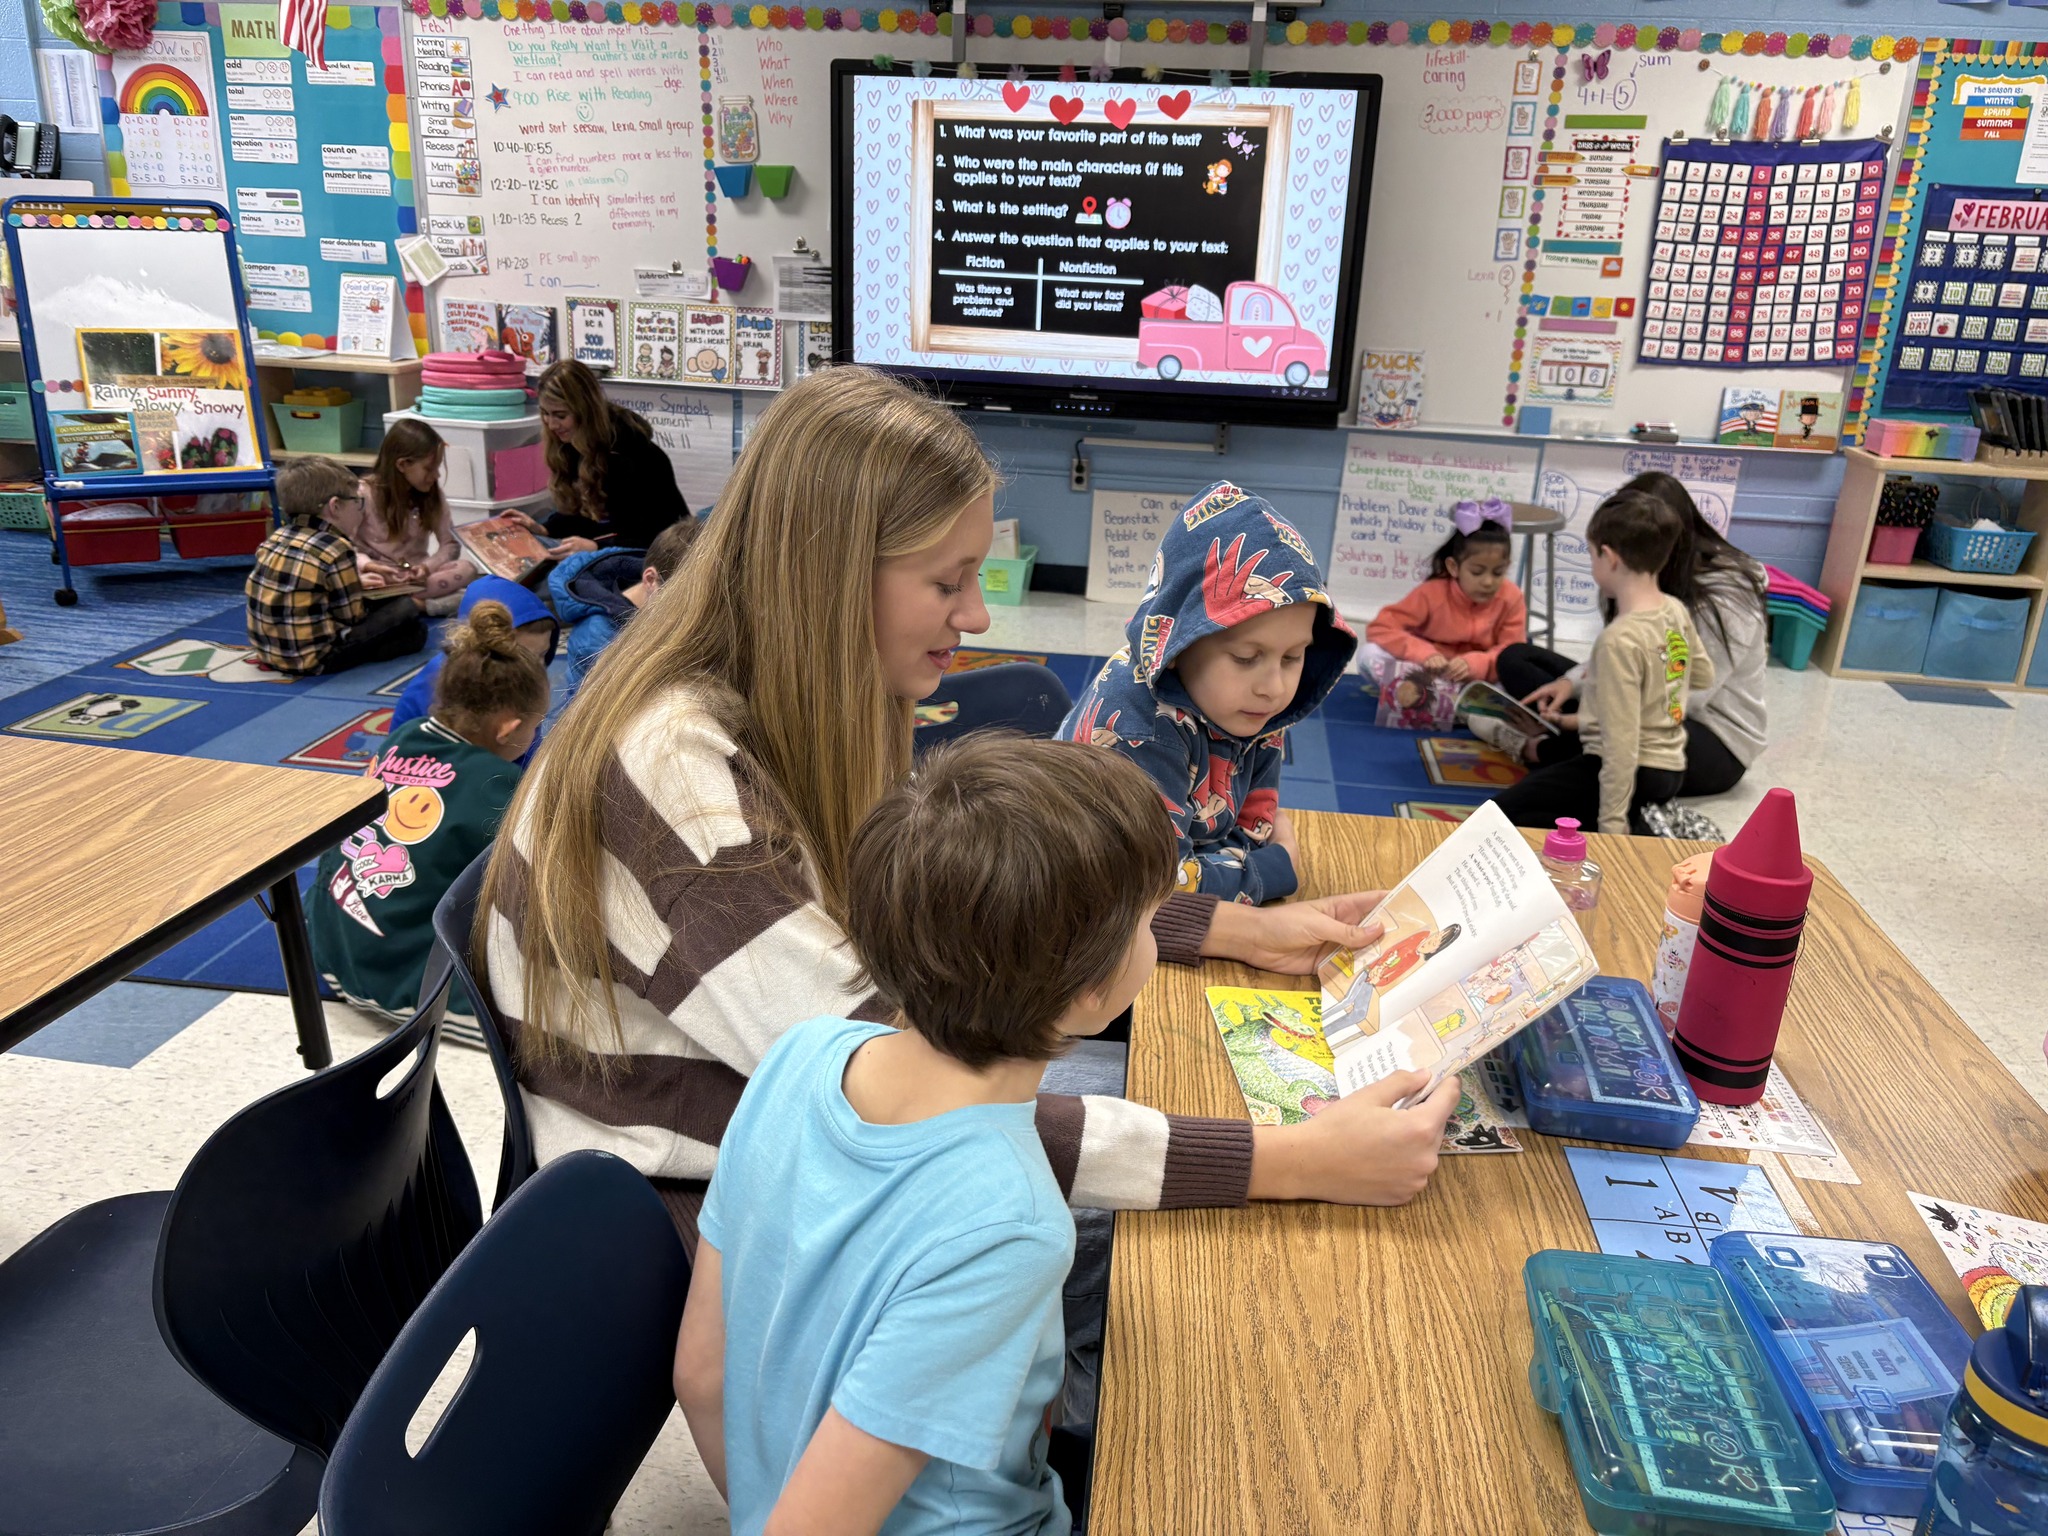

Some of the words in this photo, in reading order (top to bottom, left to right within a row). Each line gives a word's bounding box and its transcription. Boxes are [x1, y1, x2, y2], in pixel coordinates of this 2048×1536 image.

[231, 19, 276, 40] MATH
[559, 24, 576, 34] love
[581, 24, 604, 35] about
[607, 26, 631, 41] myself
[417, 39, 444, 48] Morning
[508, 41, 524, 51] Do
[529, 43, 546, 53] you
[551, 41, 578, 54] Really
[584, 40, 611, 51] Want
[631, 39, 656, 50] Visit
[660, 41, 668, 50] a
[756, 36, 783, 53] Who
[418, 48, 446, 57] Meeting
[514, 53, 562, 67] Wetland?
[661, 50, 689, 60] words
[226, 60, 242, 69] add
[418, 62, 449, 73] Reading
[759, 56, 791, 70] What
[527, 71, 546, 81] can
[549, 69, 572, 79] read
[577, 66, 595, 78] and
[600, 66, 623, 83] spell
[626, 66, 656, 77] words
[420, 82, 450, 91] Phonics
[762, 76, 794, 90] When
[228, 87, 244, 95] total
[547, 89, 572, 102] Rise
[579, 86, 606, 101] with
[612, 89, 652, 107] Reading
[421, 101, 449, 112] Writing
[764, 94, 798, 107] Where
[768, 110, 793, 129] Why
[428, 127, 450, 136] Group
[519, 122, 545, 135] word
[549, 121, 567, 133] sort
[639, 119, 663, 132] small
[666, 120, 694, 137] group
[954, 125, 986, 139] What
[988, 128, 1014, 140] was
[1017, 129, 1045, 143] your
[1049, 128, 1097, 143] favorite
[1100, 131, 1128, 146] part
[1130, 132, 1145, 144] of
[1148, 132, 1168, 145] the
[1172, 133, 1202, 147] text?
[232, 139, 263, 148] equation
[425, 142, 455, 151] Recess
[579, 153, 616, 164] numbers
[431, 163, 453, 172] Math
[953, 155, 980, 169] Who
[983, 158, 1015, 170] were
[1018, 157, 1038, 171] the
[1042, 159, 1073, 172] main
[1076, 159, 1142, 175] characters
[1145, 162, 1160, 176] (if
[1162, 162, 1184, 177] this
[1868, 166, 1878, 174] 10
[325, 172, 356, 180] number
[358, 171, 372, 180] line
[953, 171, 998, 187] applies
[1001, 172, 1015, 185] to
[1017, 175, 1046, 188] your
[1049, 173, 1082, 188] text)?
[431, 180, 457, 188] Lunch
[1863, 186, 1877, 194] 20
[237, 189, 257, 197] fewer
[543, 195, 561, 205] can
[565, 194, 601, 208] identify
[952, 200, 983, 213] What
[987, 201, 997, 214] is
[1000, 202, 1019, 215] the
[1022, 203, 1069, 218] setting?
[1858, 206, 1872, 215] 30
[432, 220, 451, 229] Pack
[453, 220, 465, 231] Up
[541, 213, 568, 226] Recess
[574, 213, 582, 226] 2
[362, 240, 376, 248] facts
[951, 229, 996, 244] Answer
[999, 231, 1019, 245] the
[1022, 233, 1073, 248] question
[1077, 235, 1102, 249] that
[1105, 237, 1150, 252] applies
[1153, 238, 1167, 251] to
[1169, 240, 1199, 254] your
[1201, 239, 1229, 254] text:
[244, 264, 276, 272] compare
[965, 255, 1005, 269] Fiction
[1059, 261, 1117, 275] Nonfiction
[524, 273, 532, 286] I
[540, 275, 561, 287] can
[955, 283, 975, 293] Was
[977, 284, 1002, 295] there
[1004, 286, 1012, 295] a
[1055, 288, 1081, 299] What
[1082, 291, 1103, 300] new
[1105, 290, 1125, 300] fact
[953, 295, 993, 306] problem
[995, 297, 1014, 307] and
[1055, 300, 1072, 310] did
[1073, 302, 1092, 311] you
[1094, 300, 1124, 312] learn?
[588, 309, 605, 317] CAN
[963, 307, 1004, 318] solution?
[1909, 322, 1928, 331] DAY
[1367, 354, 1420, 372] DUCK
[93, 384, 141, 401] Rainy,
[147, 386, 199, 402] Sunny,
[135, 399, 185, 416] Blowy,
[193, 400, 245, 419] Snowy
[660, 394, 709, 415] Symbols
[1141, 498, 1164, 509] Can
[1398, 500, 1428, 517] Dave
[1388, 516, 1426, 533] holiday
[1108, 545, 1129, 558] Read
[372, 745, 456, 780] Justice
[394, 776, 430, 785] SPORT
[355, 858, 373, 871] GOOD
[368, 873, 409, 887] KARMA
[1605, 1175, 1659, 1188] 1
[1653, 1206, 1680, 1221] A
[1664, 1229, 1692, 1244] B
